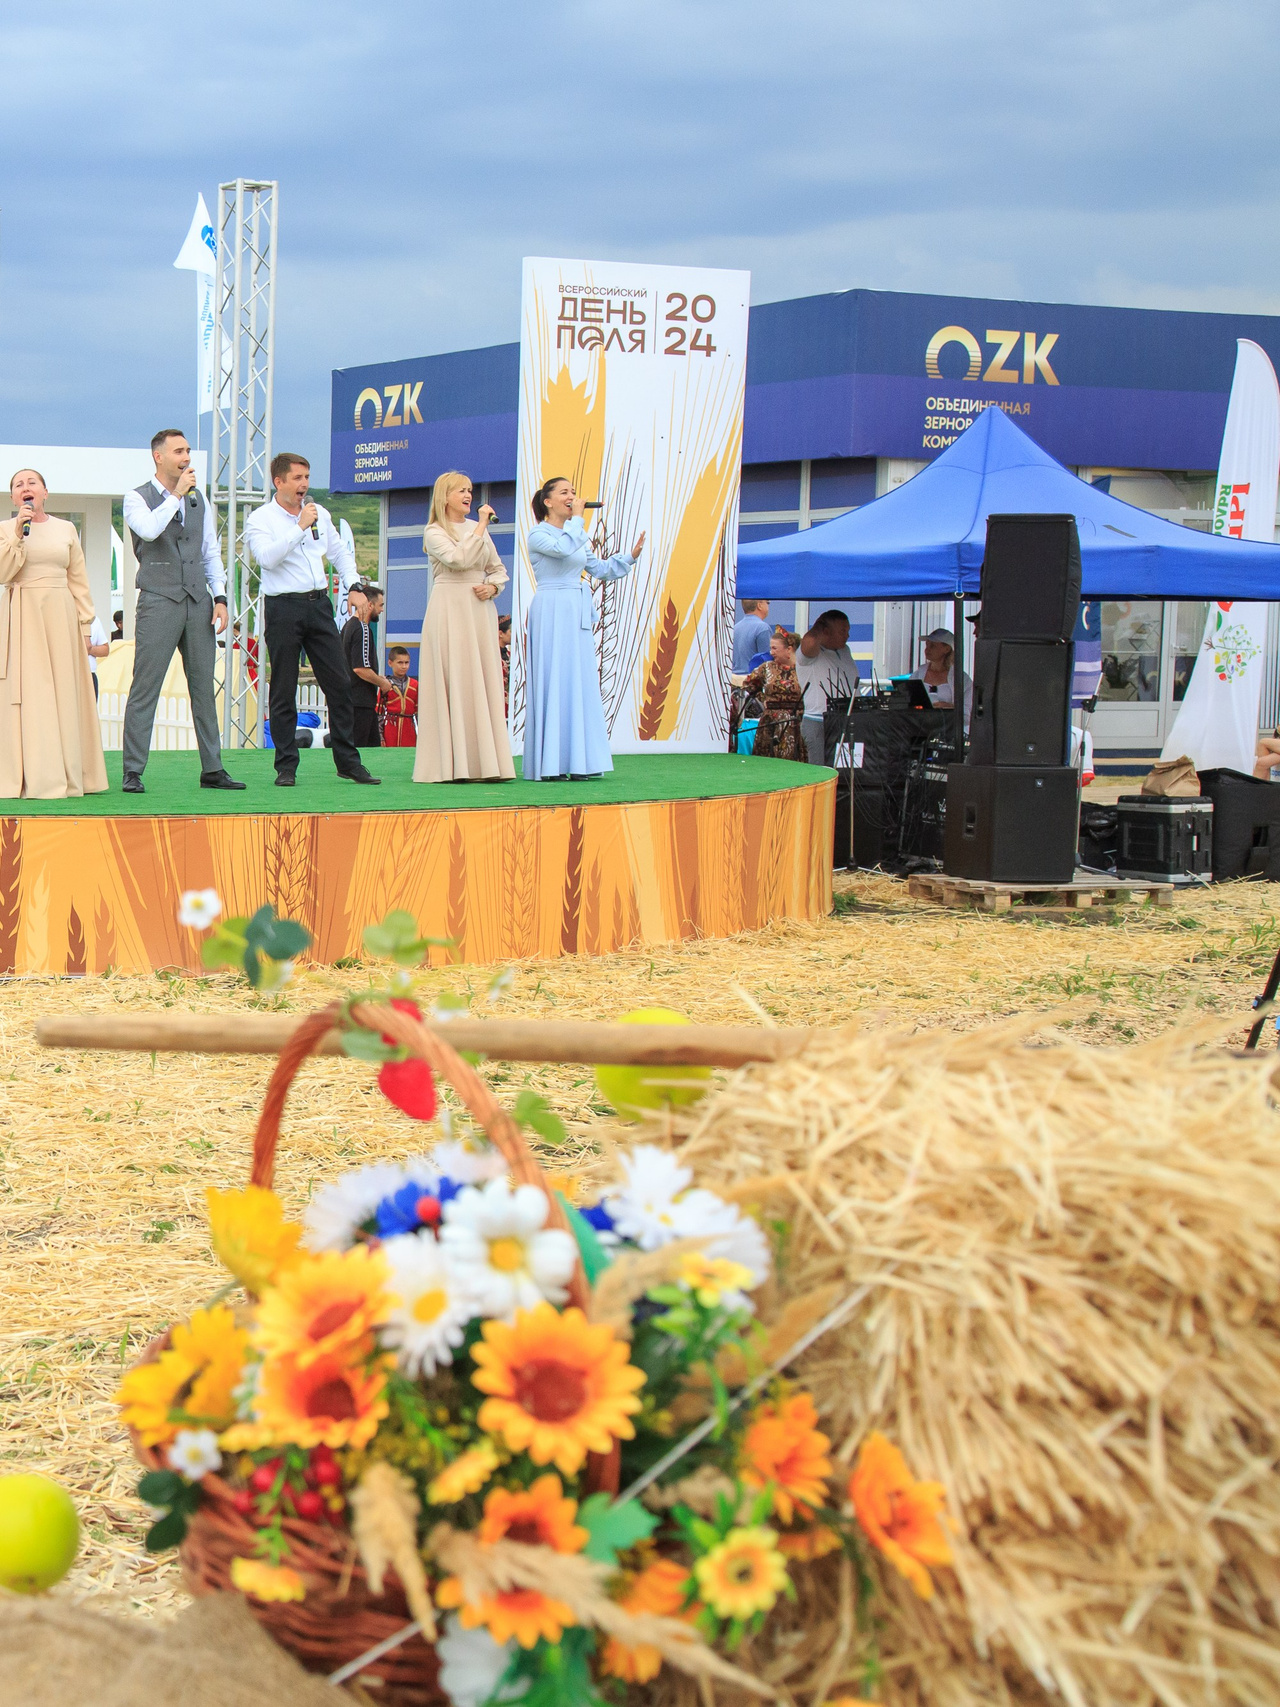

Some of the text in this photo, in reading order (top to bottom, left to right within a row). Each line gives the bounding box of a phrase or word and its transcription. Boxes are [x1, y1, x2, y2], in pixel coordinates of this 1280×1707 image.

[558, 284, 648, 299] ВСЕРОССИЙСКИЙ
[557, 296, 647, 325] ДЕНЬ
[665, 292, 717, 324] 20
[556, 324, 646, 354] ПОЛЯ
[664, 326, 717, 358] 24
[925, 325, 1061, 386] OZK
[354, 381, 424, 431] OZK
[354, 440, 409, 455] ОБЪЕДИНЕННАЯ
[354, 456, 389, 469] ЗЕРНОВАЯ
[354, 471, 393, 483] КОМПАНИЯ
